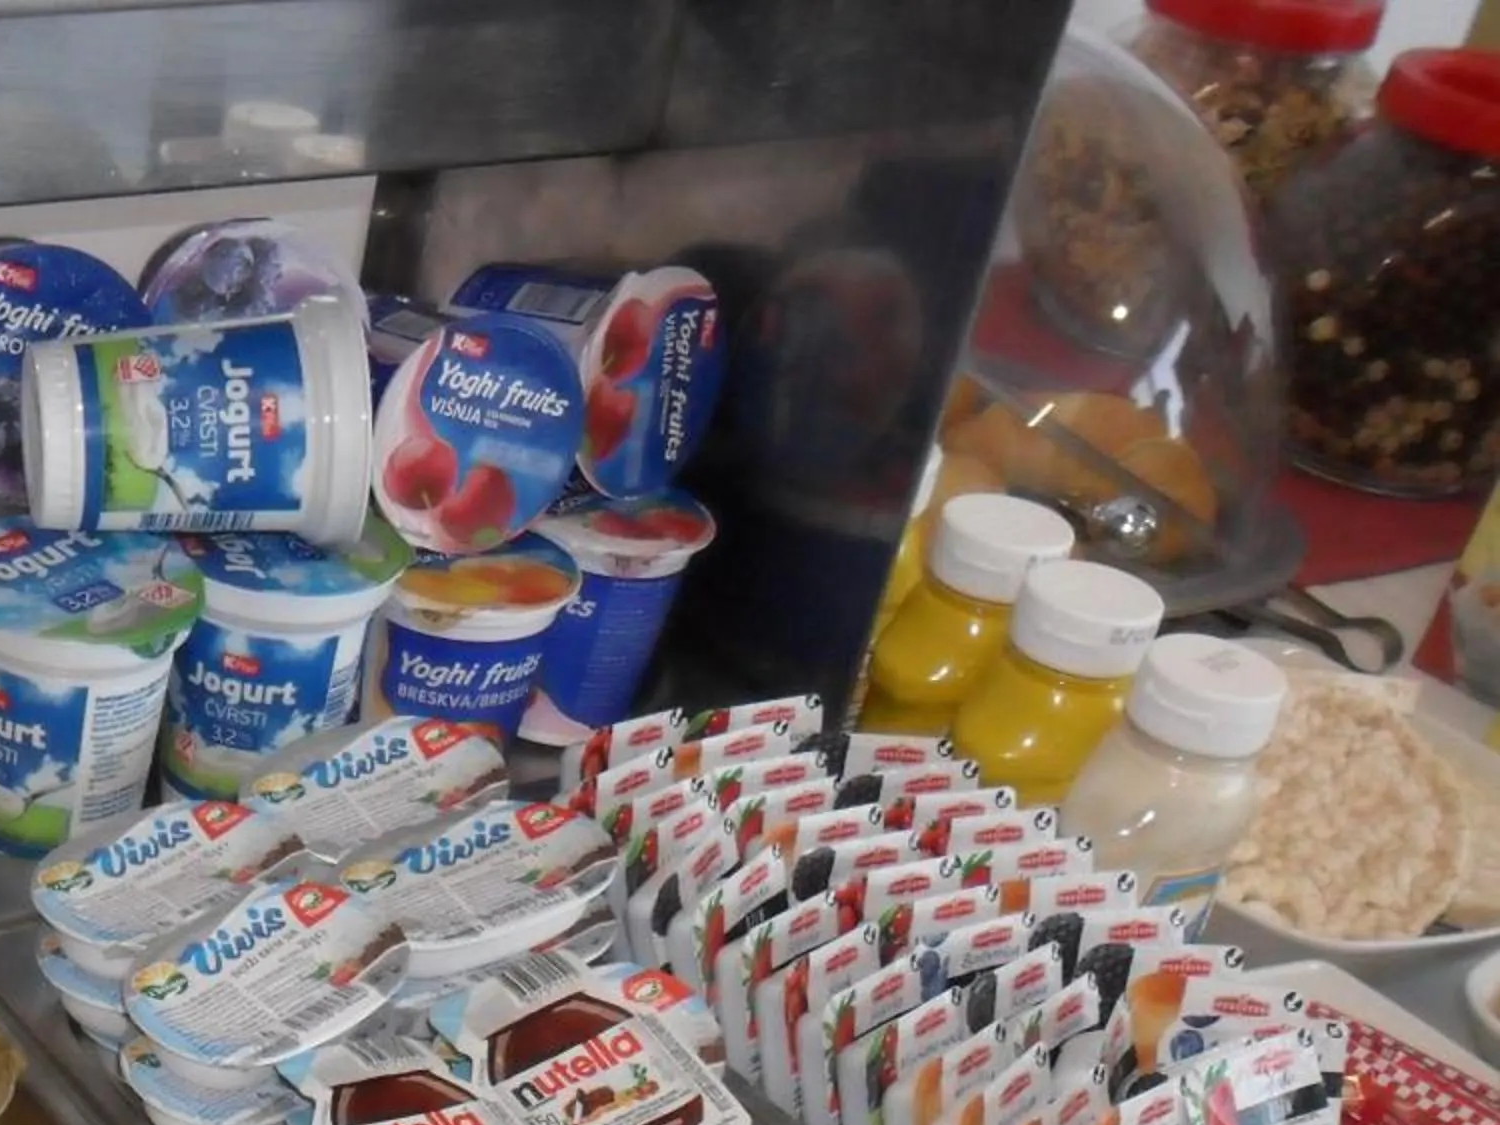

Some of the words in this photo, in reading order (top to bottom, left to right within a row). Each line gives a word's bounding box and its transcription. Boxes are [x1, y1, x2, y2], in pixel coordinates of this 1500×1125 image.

[675, 311, 699, 385] Yoghi
[430, 395, 481, 426] VIŠNJA
[437, 359, 505, 401] Yoghi
[500, 379, 570, 418] fruits
[197, 384, 220, 457] ČVRSTI
[220, 358, 256, 484] Jogurt
[664, 387, 688, 462] fruits
[188, 661, 297, 706] Jogurt
[400, 650, 481, 687] Yoghi
[478, 652, 543, 691] fruits
[302, 735, 409, 789] Vivis
[87, 819, 192, 878] Vivis
[395, 819, 511, 875] Vivis
[178, 906, 287, 976] Vivis
[512, 1029, 644, 1109] nutella
